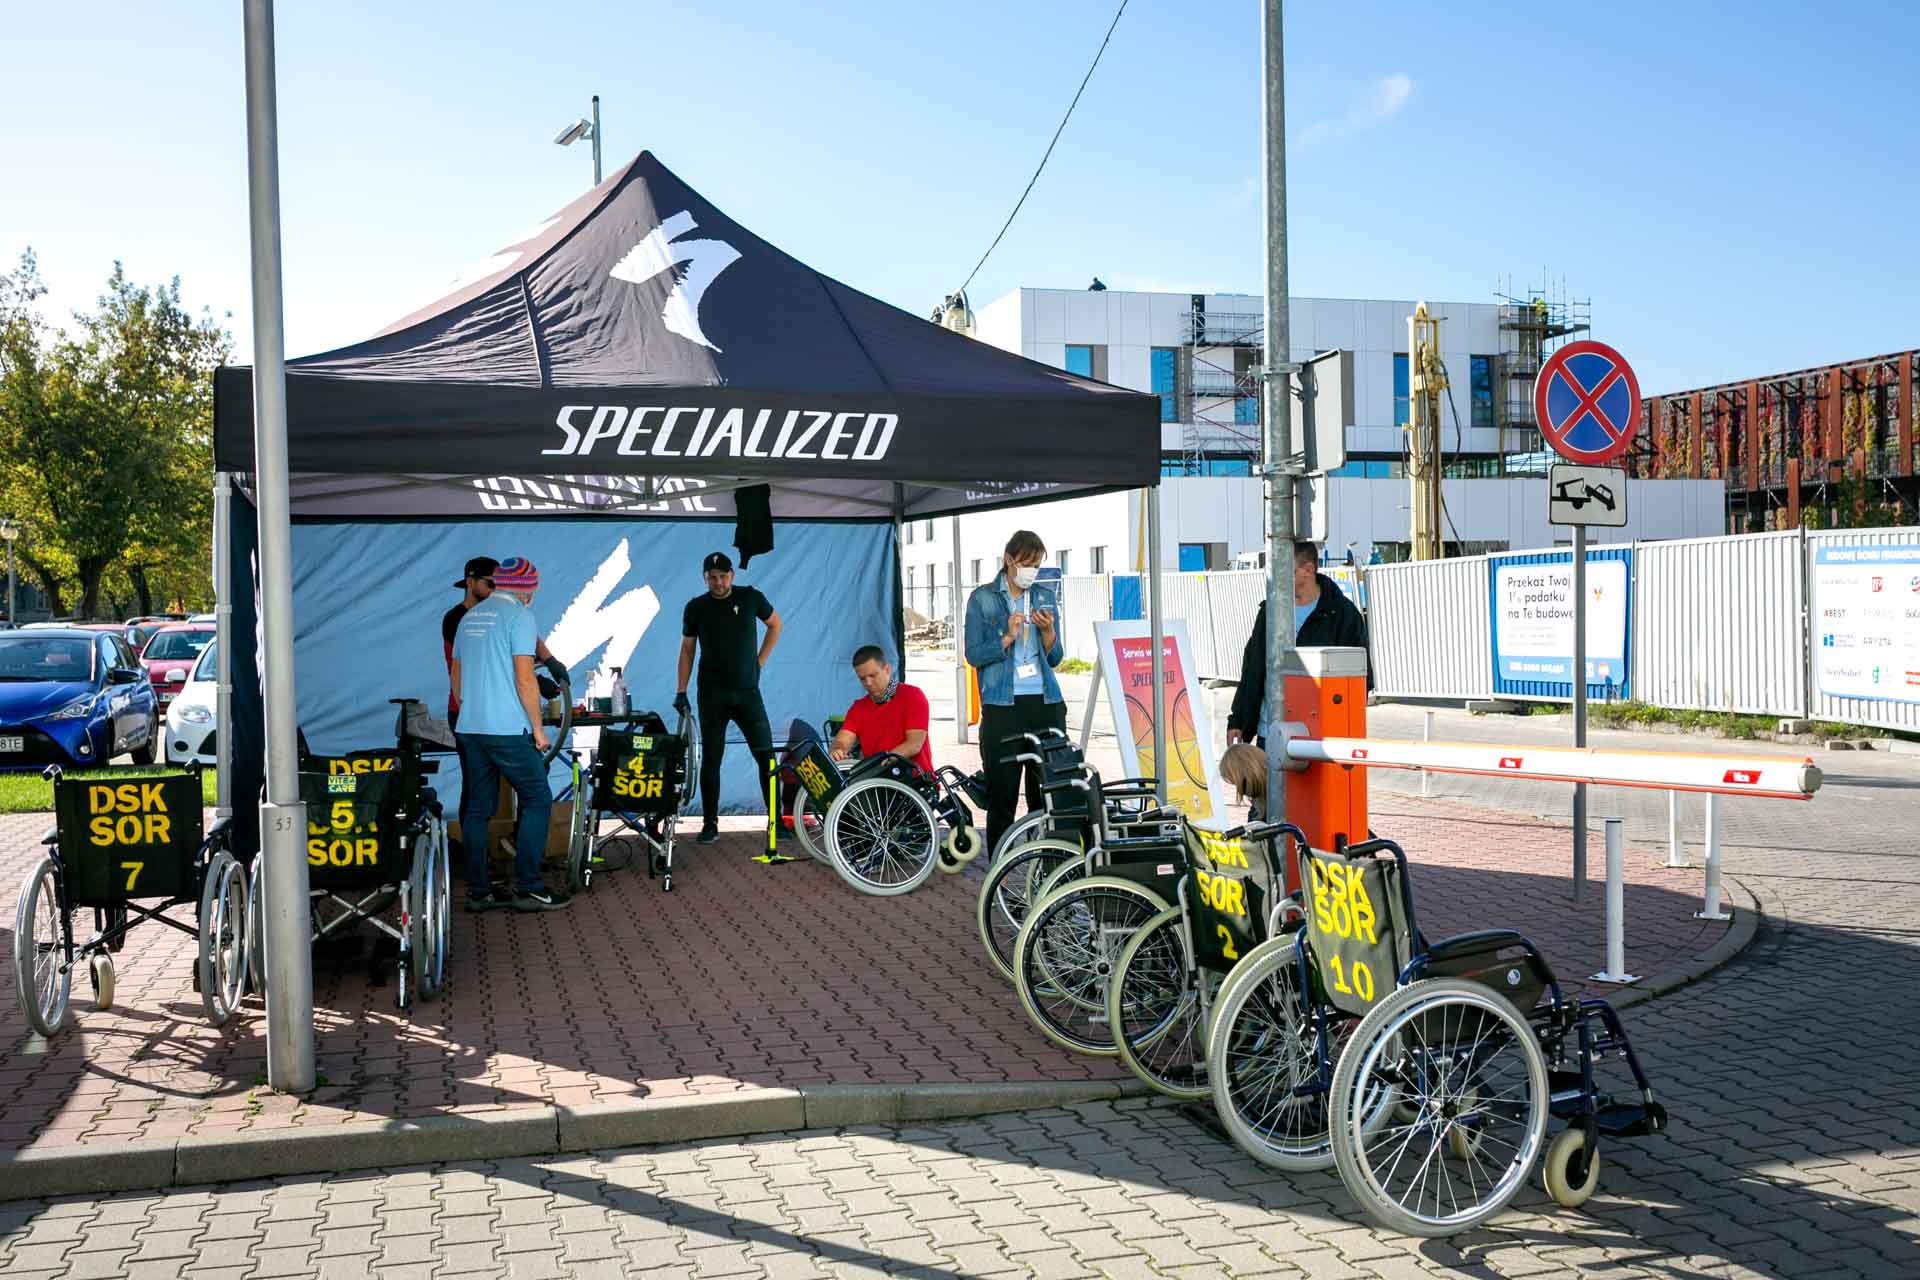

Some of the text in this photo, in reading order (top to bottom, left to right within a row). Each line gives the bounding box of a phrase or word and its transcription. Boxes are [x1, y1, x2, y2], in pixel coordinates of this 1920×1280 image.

[541, 406, 898, 460] SPECIALIZED
[1507, 611, 1520, 619] na
[628, 752, 644, 774] 4
[89, 783, 168, 815] DSK
[612, 775, 663, 798] SOR
[89, 815, 172, 846] SOR
[330, 801, 355, 830] 5
[307, 838, 379, 867] SOR
[120, 862, 144, 891] 7
[1310, 857, 1371, 907] DSK
[1196, 870, 1246, 916] SOR
[1313, 894, 1378, 945] SOR
[1216, 923, 1239, 960] 2
[1329, 953, 1375, 1002] 10
